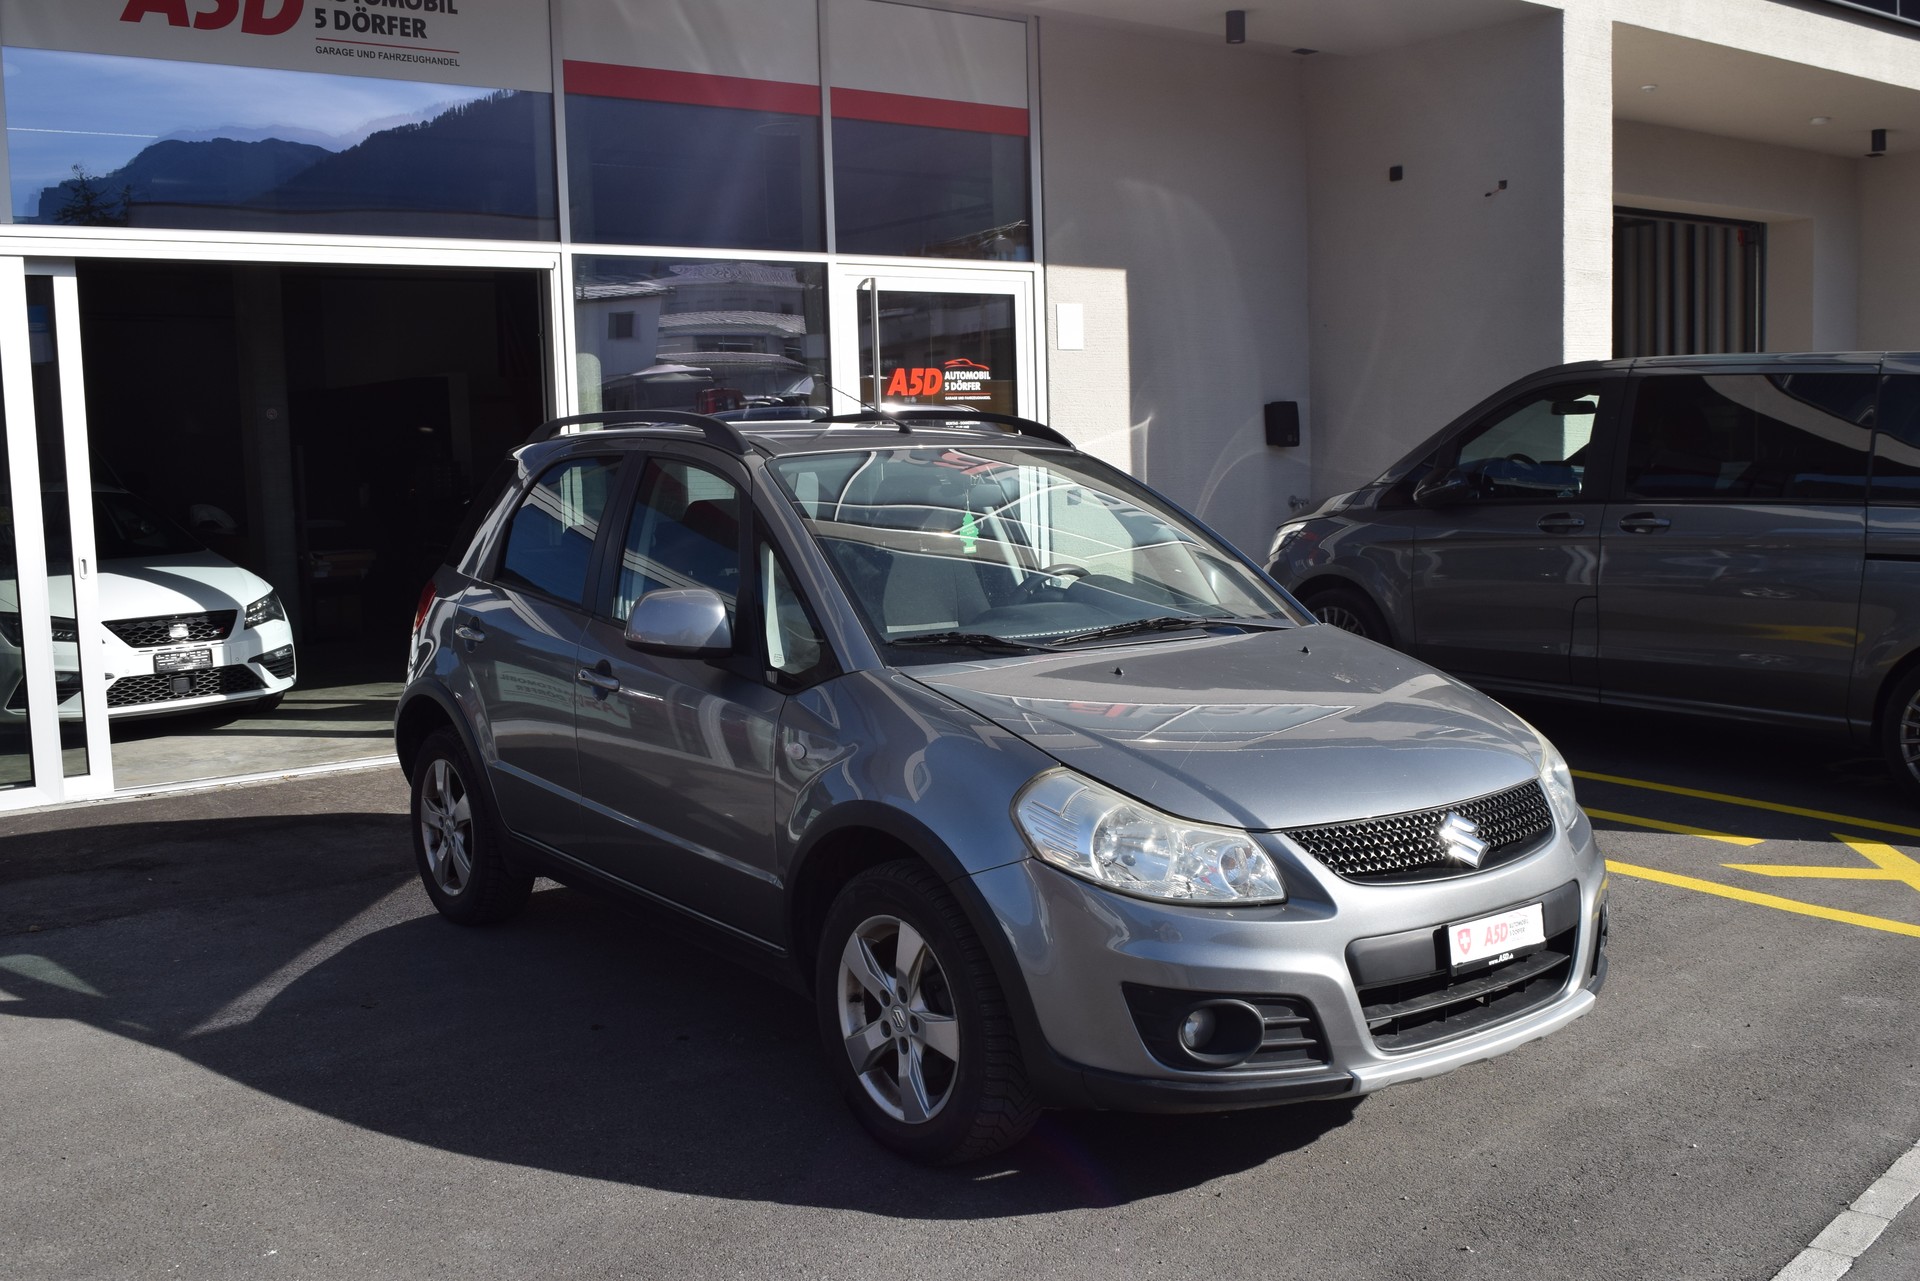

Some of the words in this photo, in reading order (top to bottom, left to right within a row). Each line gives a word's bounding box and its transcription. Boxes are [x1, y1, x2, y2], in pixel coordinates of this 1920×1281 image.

[314, 7, 327, 29] 5
[333, 6, 428, 39] DÖRFER
[315, 46, 354, 57] GARAGE
[357, 50, 376, 59] UND
[378, 52, 460, 67] FAHRZEUGHANDEL
[887, 367, 943, 396] A5D
[944, 371, 991, 380] AUTOMOBIL
[944, 382, 950, 391] 5
[950, 380, 981, 391] DÖRFER
[1484, 922, 1508, 947] A5D
